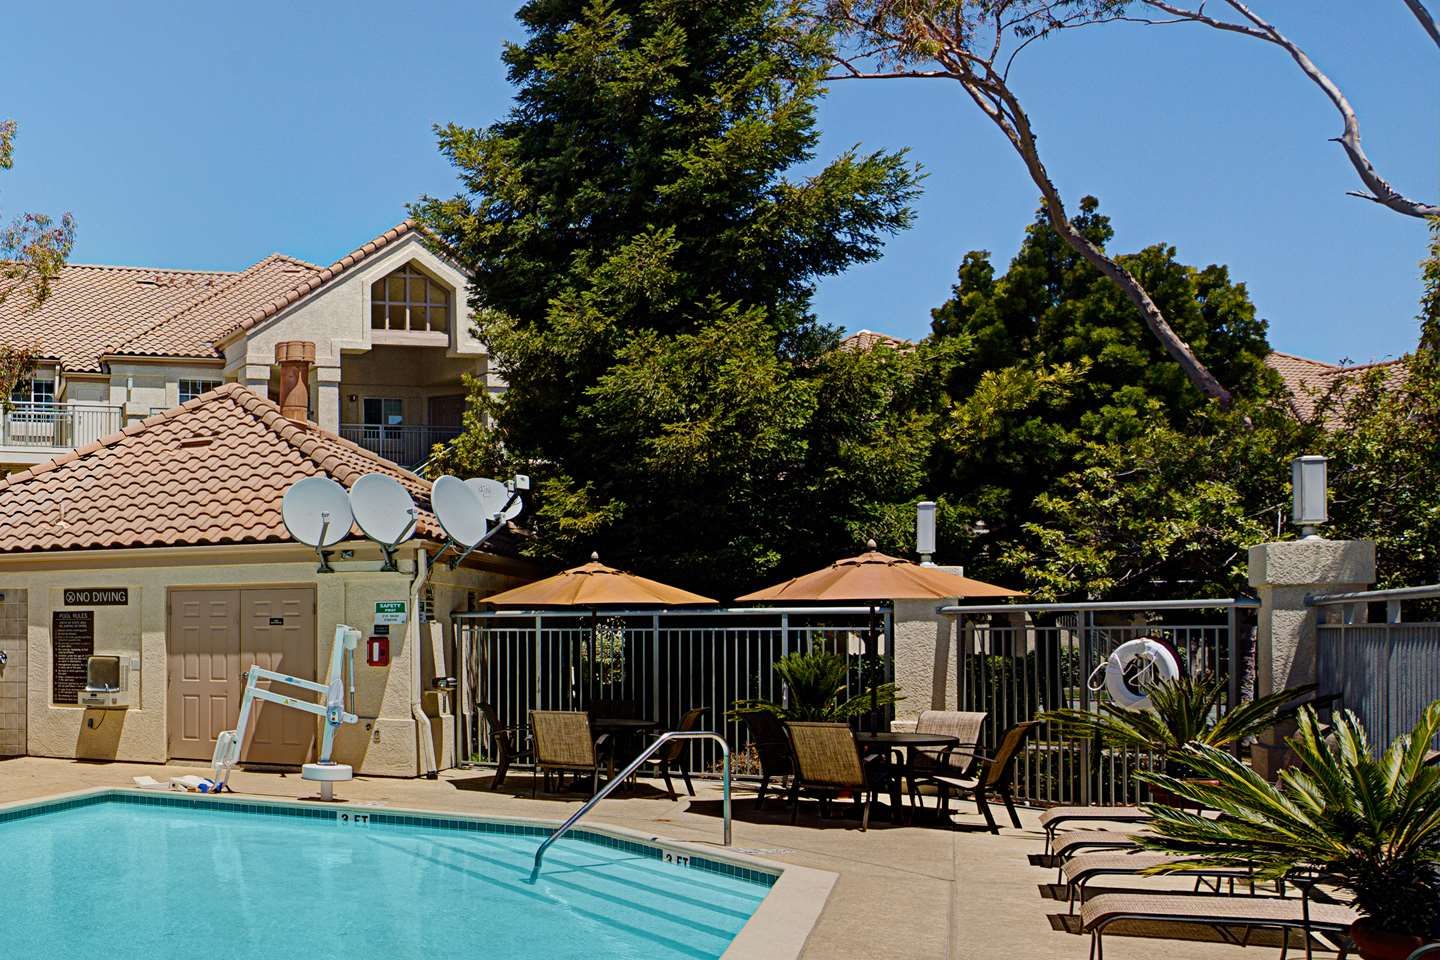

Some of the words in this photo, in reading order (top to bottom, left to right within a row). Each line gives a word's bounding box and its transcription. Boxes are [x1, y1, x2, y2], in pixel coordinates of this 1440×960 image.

[76, 592, 90, 602] NO
[92, 592, 126, 602] DIVING
[354, 814, 368, 824] FT
